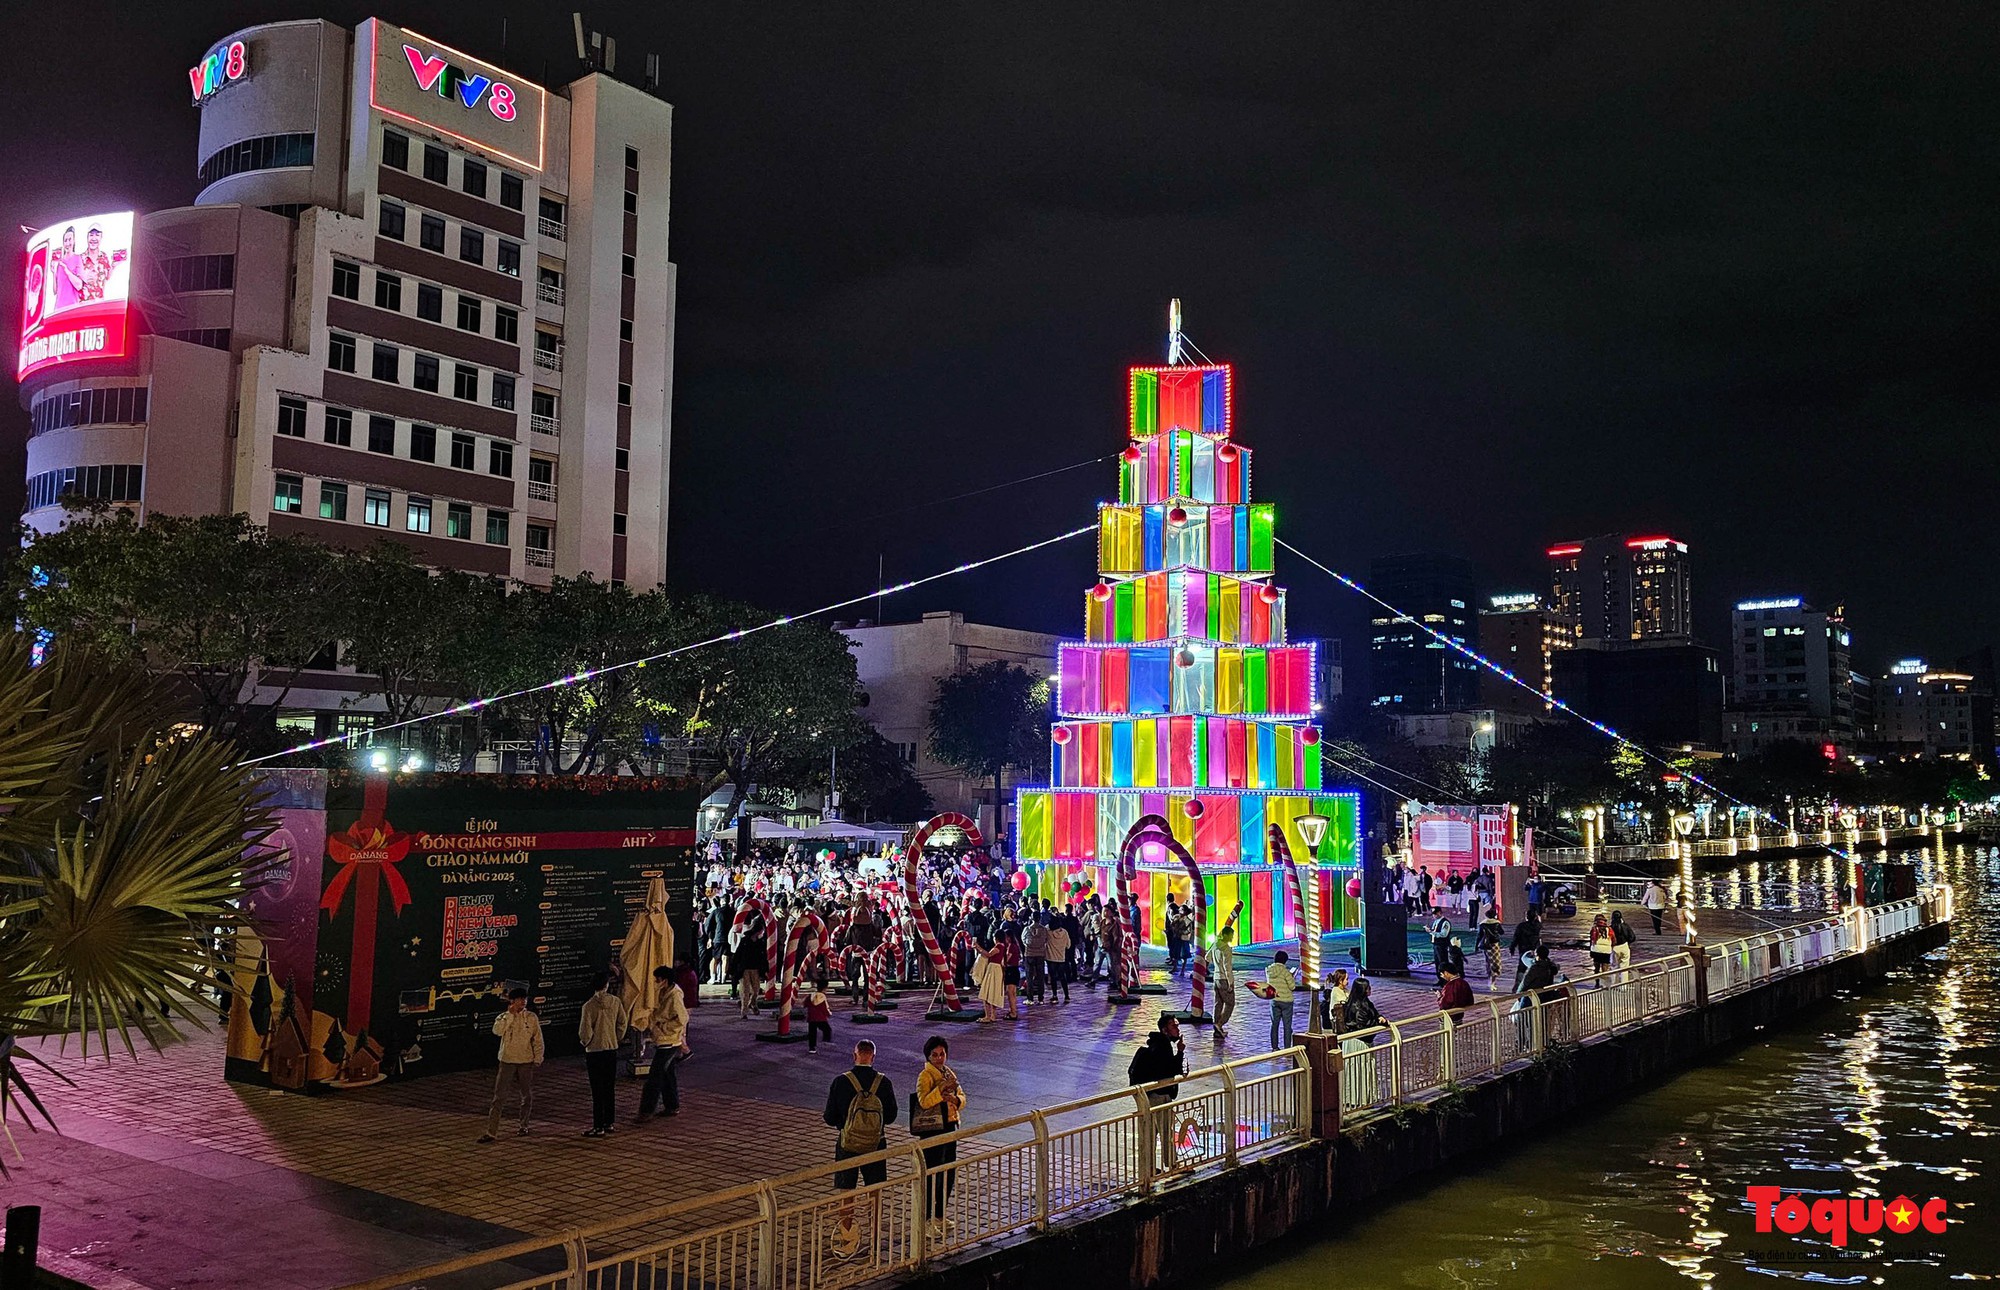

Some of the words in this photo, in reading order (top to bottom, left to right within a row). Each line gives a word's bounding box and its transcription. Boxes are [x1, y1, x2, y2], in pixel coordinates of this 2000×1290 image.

[189, 41, 245, 100] VTV8
[402, 45, 517, 121] VTV8
[79, 328, 105, 352] TW3
[476, 819, 498, 833] HỘI
[421, 834, 456, 850] ĐÓN
[457, 835, 502, 851] GIÁNG
[503, 836, 537, 849] SINH
[349, 851, 389, 861] DANANG
[426, 852, 468, 867] CHÀO
[469, 851, 501, 866] NĂM
[502, 850, 530, 865] MỚI
[441, 871, 457, 884] ĐÀ
[491, 872, 515, 882] 2025
[458, 895, 495, 906] ENJOY
[458, 904, 494, 917] XMAS
[457, 916, 485, 929] NEW
[485, 914, 518, 928] YEAR
[456, 927, 509, 941] FESTIVAL
